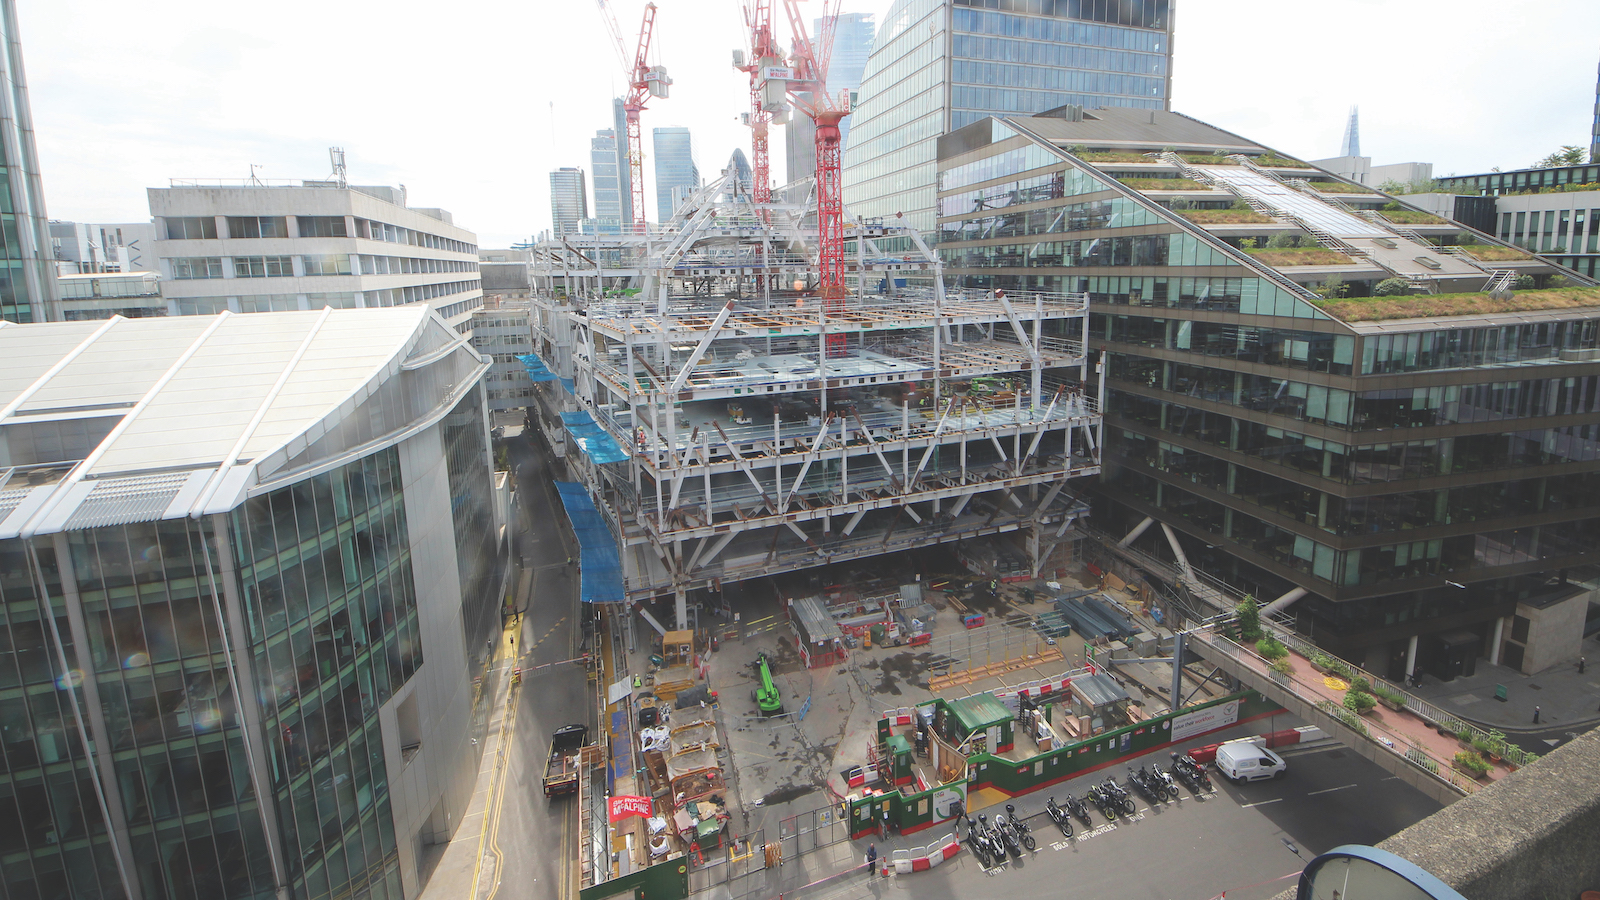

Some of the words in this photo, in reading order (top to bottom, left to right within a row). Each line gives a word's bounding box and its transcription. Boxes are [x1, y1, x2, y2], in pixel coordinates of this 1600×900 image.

[1195, 715, 1215, 724] workforce
[1053, 841, 1068, 851] SOLO
[1077, 823, 1117, 842] MOTORCYCLES
[1130, 812, 1145, 822] ONLY
